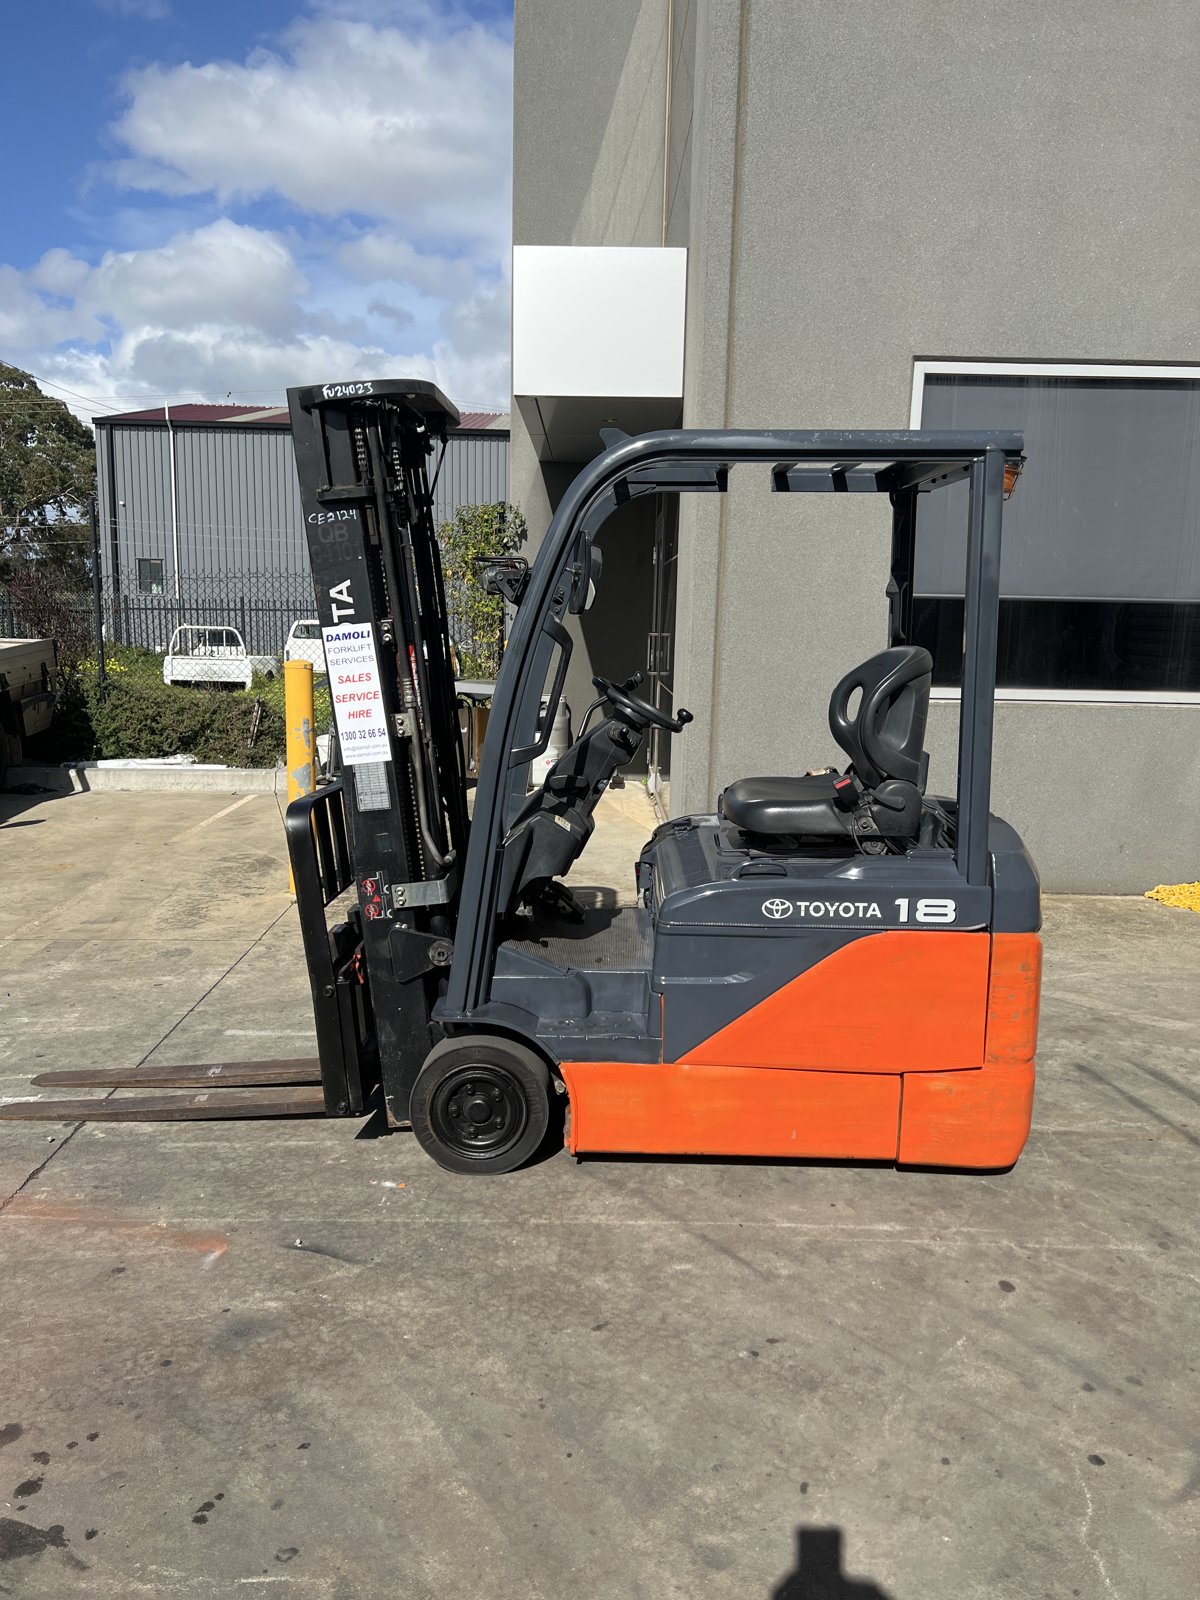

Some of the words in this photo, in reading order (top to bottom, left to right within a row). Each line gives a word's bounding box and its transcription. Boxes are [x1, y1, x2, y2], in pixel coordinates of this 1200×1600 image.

[308, 509, 357, 524] CE2124
[326, 630, 370, 642] DAMOLI
[327, 643, 372, 655] FORKLIFT
[329, 655, 375, 666] SERVICES
[337, 672, 372, 684] SALES
[335, 690, 380, 703] SERVICE
[348, 709, 373, 720] HIRE
[341, 731, 356, 741] 1300
[358, 730, 367, 739] 32
[368, 729, 376, 738] 66
[378, 728, 386, 737] 54
[796, 901, 882, 918] TOYOTA
[894, 898, 957, 924] 18
